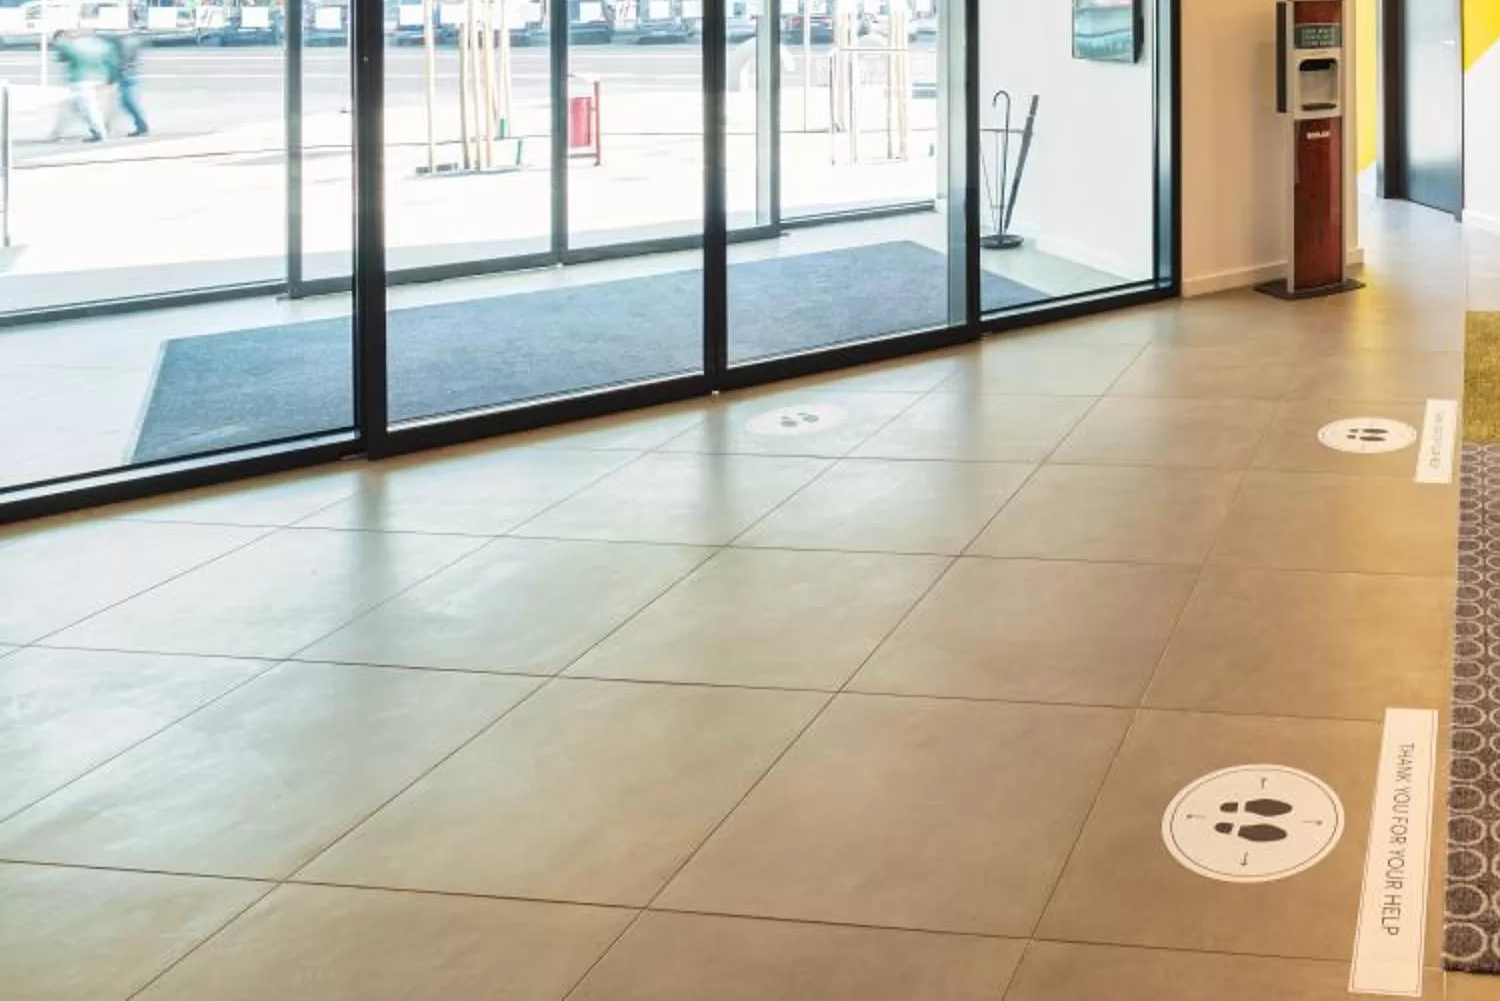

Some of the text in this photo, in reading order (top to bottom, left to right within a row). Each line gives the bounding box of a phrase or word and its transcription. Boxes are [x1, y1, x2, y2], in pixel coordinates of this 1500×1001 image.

[1381, 743, 1415, 936] THANK YOU FOR YOUR HELP
